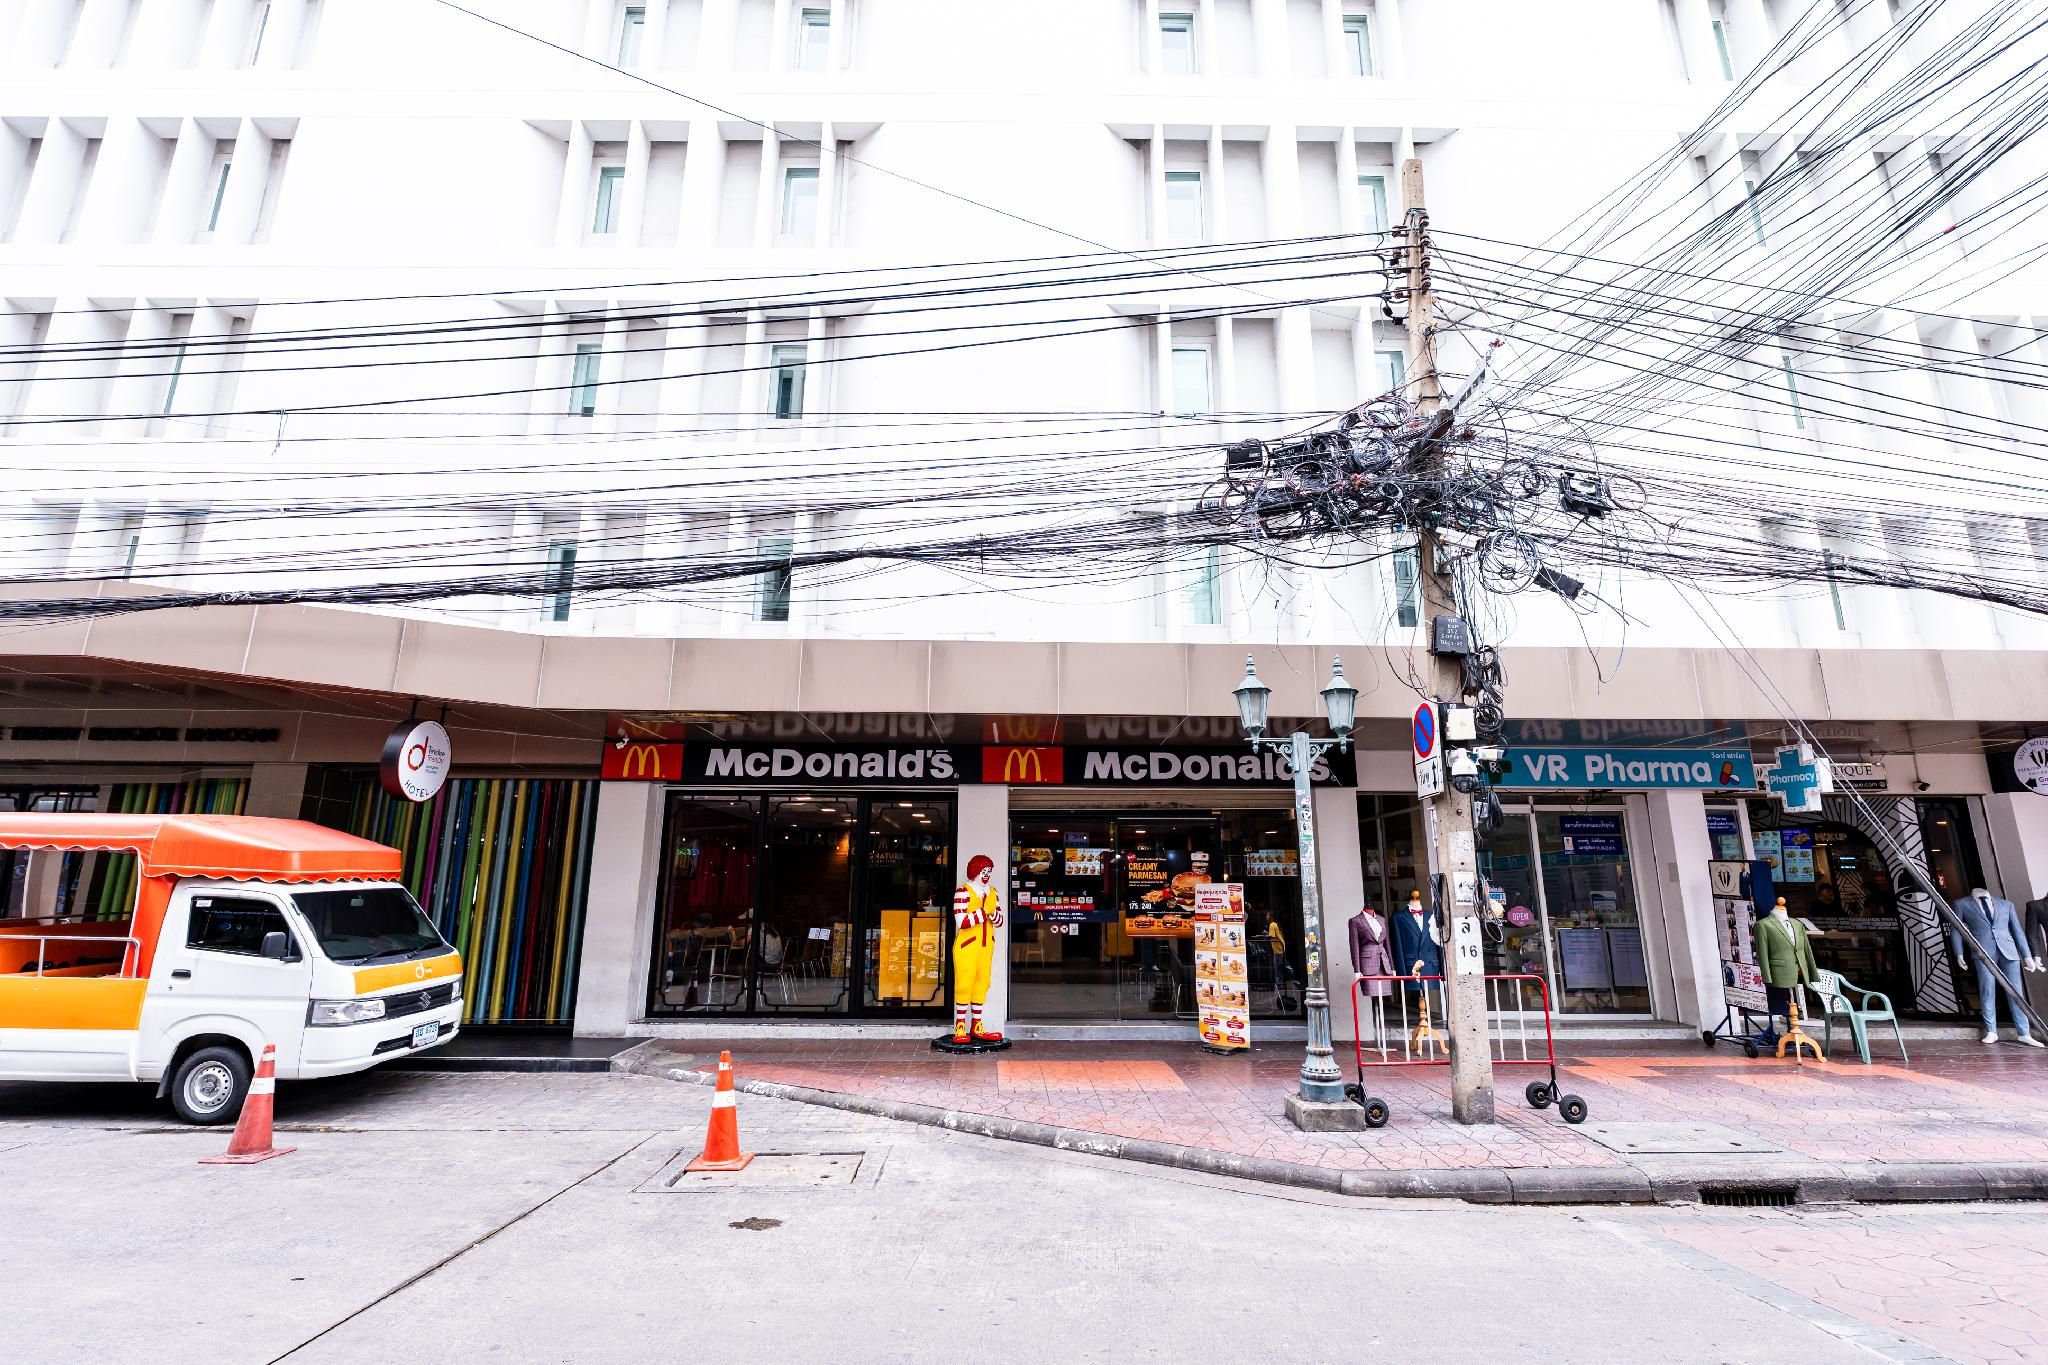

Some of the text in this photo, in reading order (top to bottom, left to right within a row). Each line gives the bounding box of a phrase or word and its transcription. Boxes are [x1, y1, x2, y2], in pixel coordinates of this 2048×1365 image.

[705, 748, 954, 778] McDonald's
[1522, 753, 1713, 783] VR Pharma
[1770, 772, 1816, 785] Pharmacy
[404, 780, 430, 798] HOTEL
[1128, 862, 1159, 871] CREAMY
[1128, 871, 1168, 880] PARMESAN
[1128, 902, 1139, 910] 175
[1512, 912, 1530, 921] OPEN
[1460, 945, 1478, 958] 16
